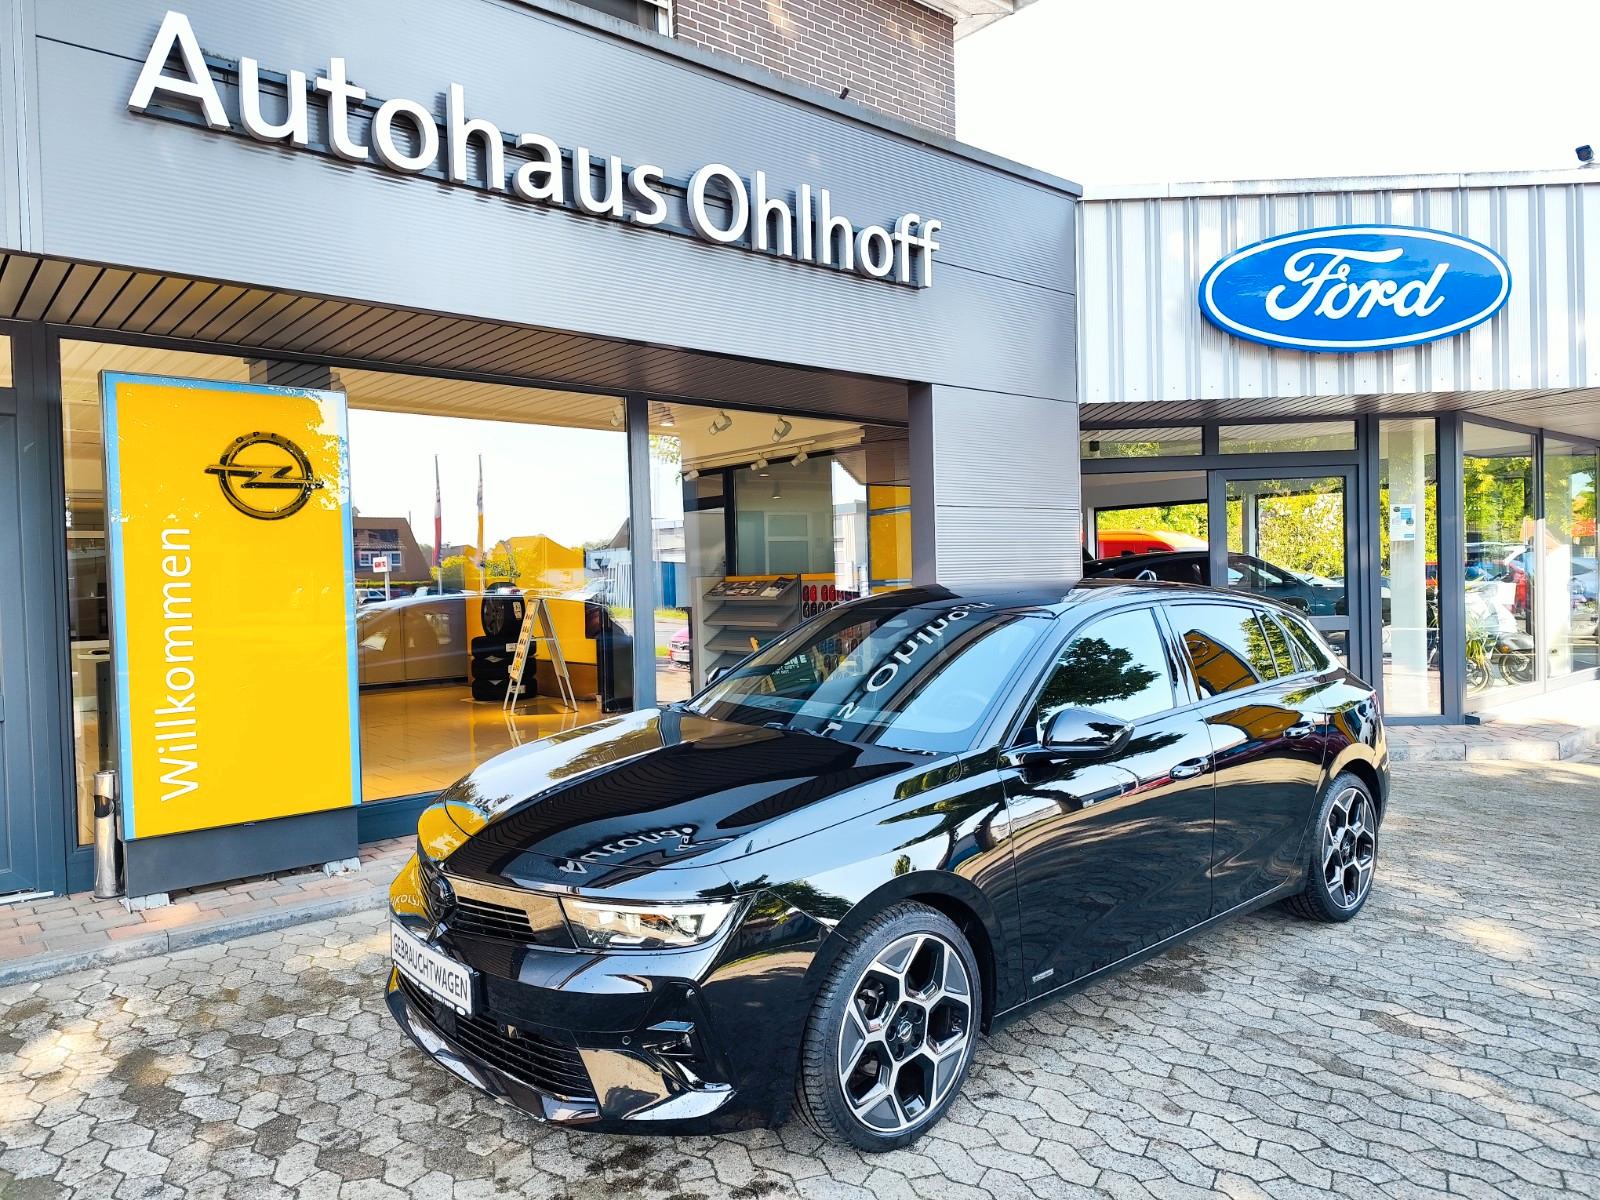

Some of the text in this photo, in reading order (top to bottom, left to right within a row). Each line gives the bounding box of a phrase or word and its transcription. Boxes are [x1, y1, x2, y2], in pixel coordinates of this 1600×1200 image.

[127, 11, 942, 289] Autohaus Ohlhoff
[1265, 246, 1450, 321] Ford
[154, 527, 200, 803] Willkommen
[392, 933, 469, 1001] GEBRAUCHTWAGEN
